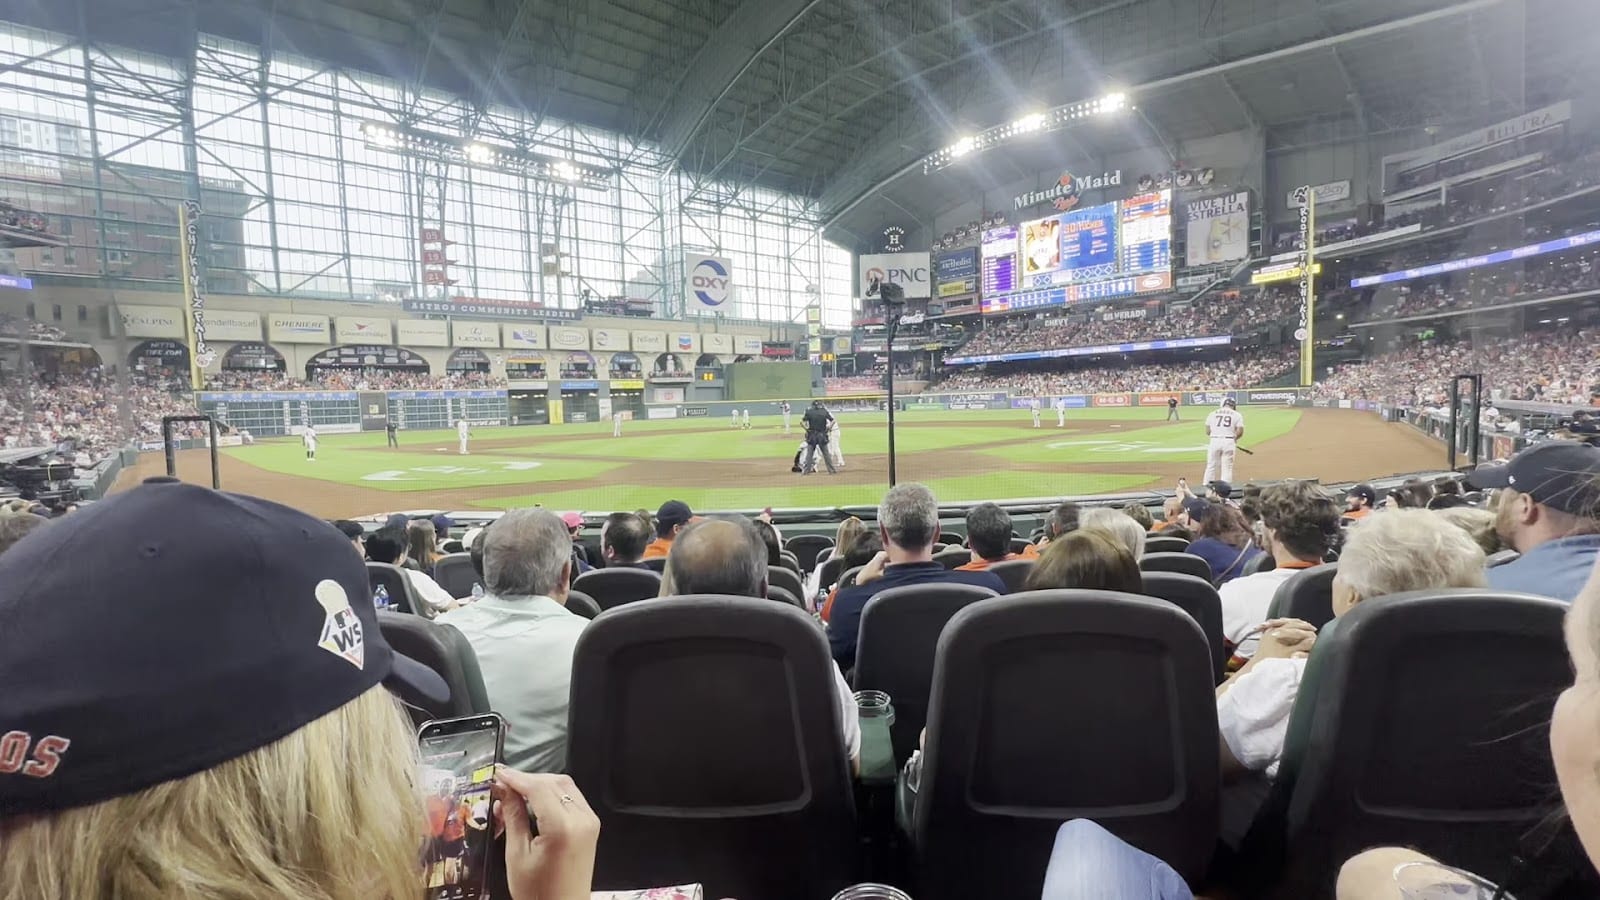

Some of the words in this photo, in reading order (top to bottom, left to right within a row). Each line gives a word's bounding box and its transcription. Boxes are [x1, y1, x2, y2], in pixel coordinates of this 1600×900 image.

[1014, 184, 1072, 210] Minute
[1075, 170, 1121, 192] Maid
[1189, 199, 1217, 212] VIVE
[1222, 194, 1237, 206] TU
[1188, 204, 1245, 222] ESTRELLA
[889, 235, 899, 245] H
[887, 268, 927, 283] PNC
[692, 276, 728, 290] OXY
[411, 302, 456, 312] ASTROS
[461, 304, 528, 316] COMMUNITY
[533, 310, 576, 319] LEADERS
[1102, 309, 1147, 322] SILVERADO
[274, 320, 324, 328] CHENIERE
[1044, 318, 1069, 327] CHEVY
[1250, 393, 1294, 401] POWERADE
[1216, 415, 1232, 427] 79
[332, 623, 362, 652] WS
[0, 730, 71, 778] OS
